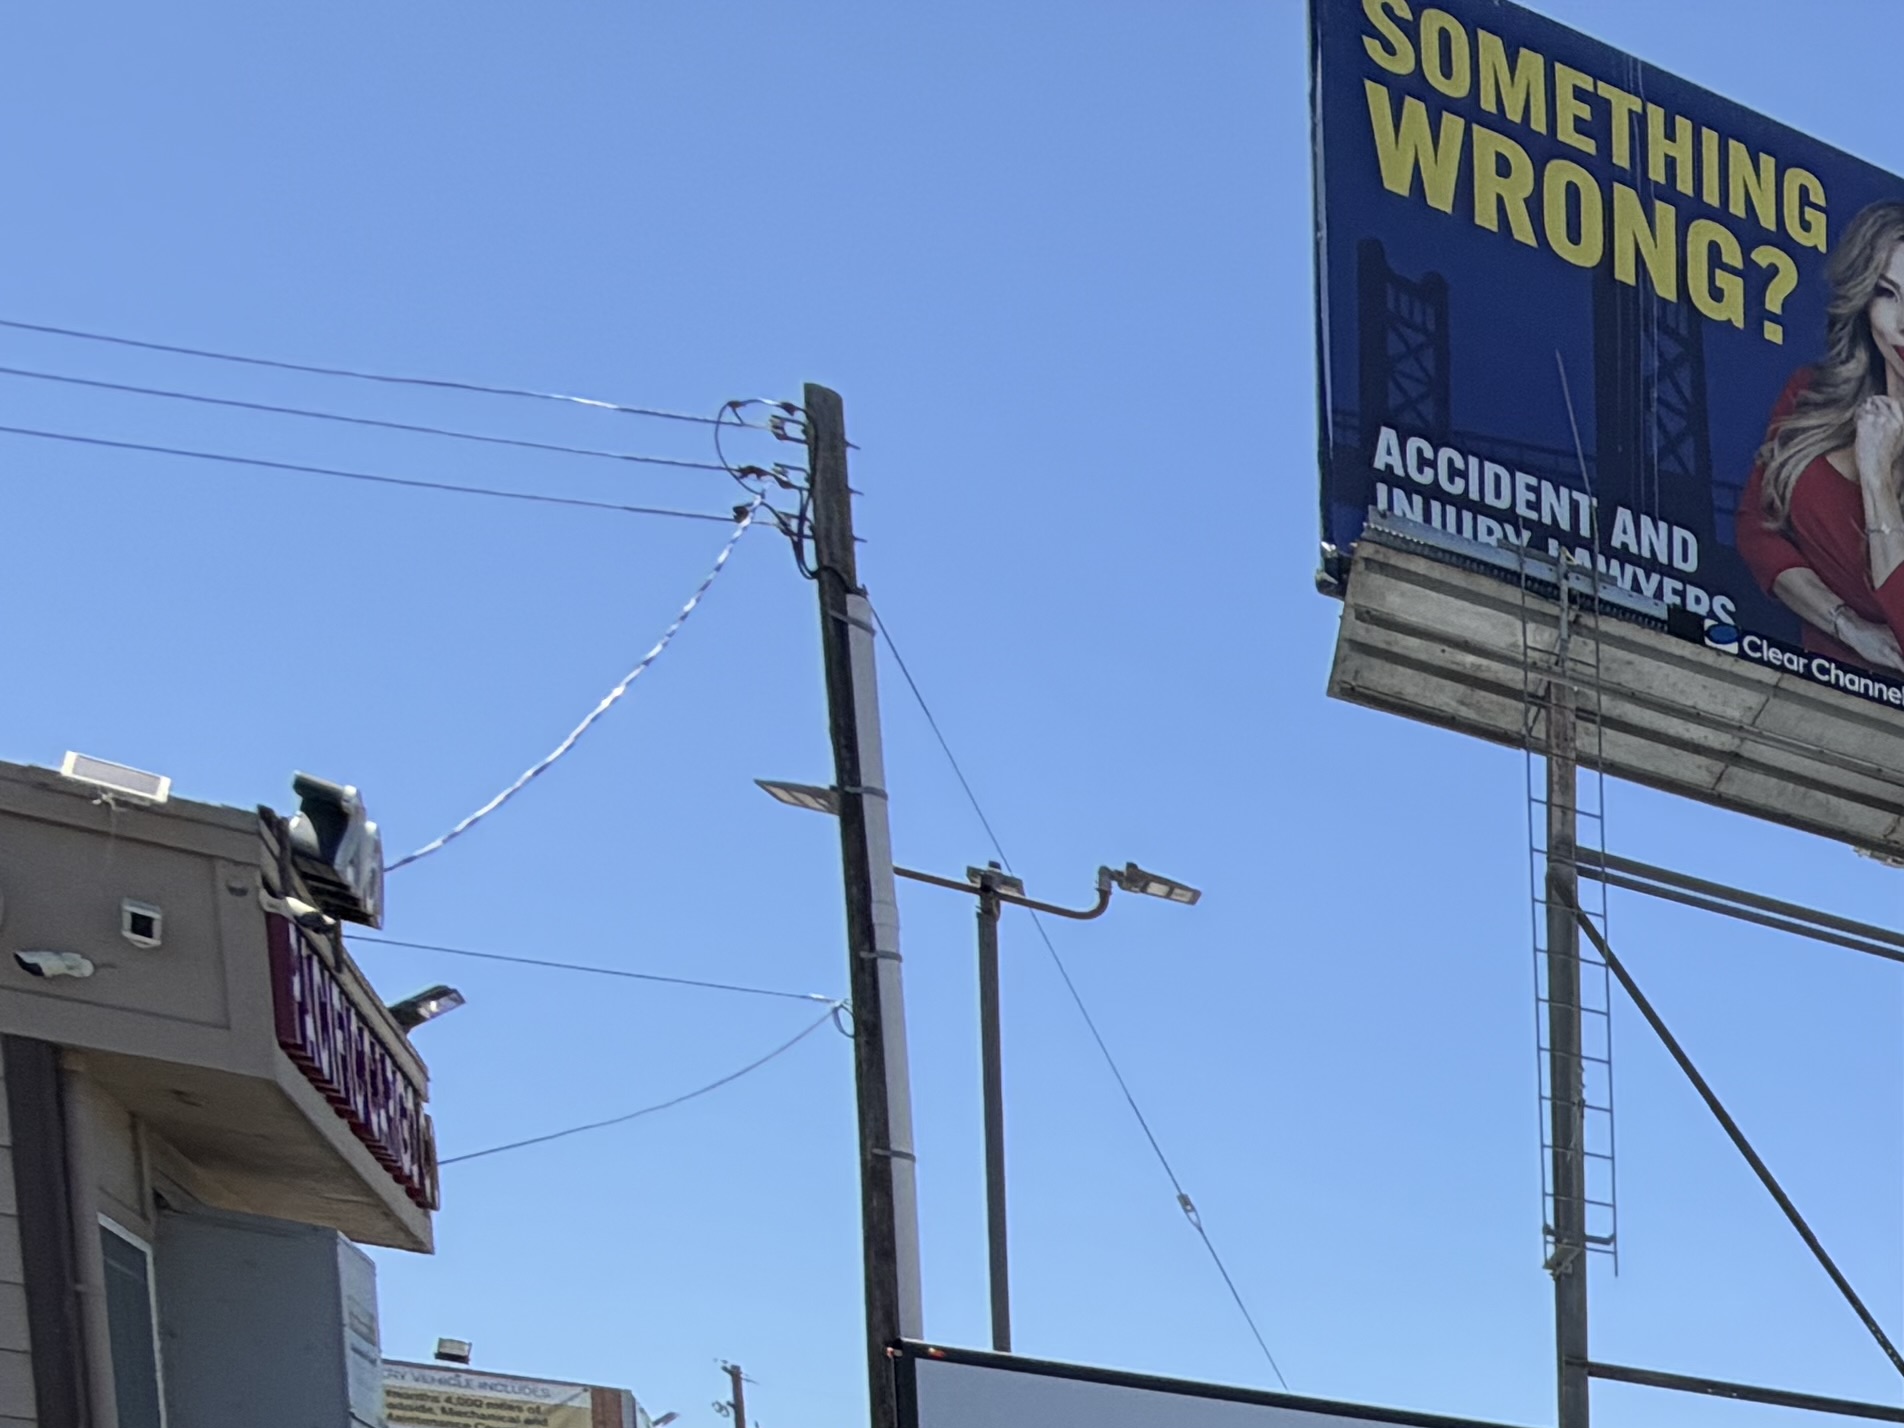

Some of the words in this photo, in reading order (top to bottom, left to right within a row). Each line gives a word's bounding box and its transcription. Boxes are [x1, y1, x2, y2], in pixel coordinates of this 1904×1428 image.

[1361, 0, 1828, 253] SOMETHING
[1363, 79, 1798, 344] WRONG?
[1373, 425, 1598, 538] ACCIDENT
[1611, 506, 1698, 573] AND
[1742, 635, 1808, 673] Clear
